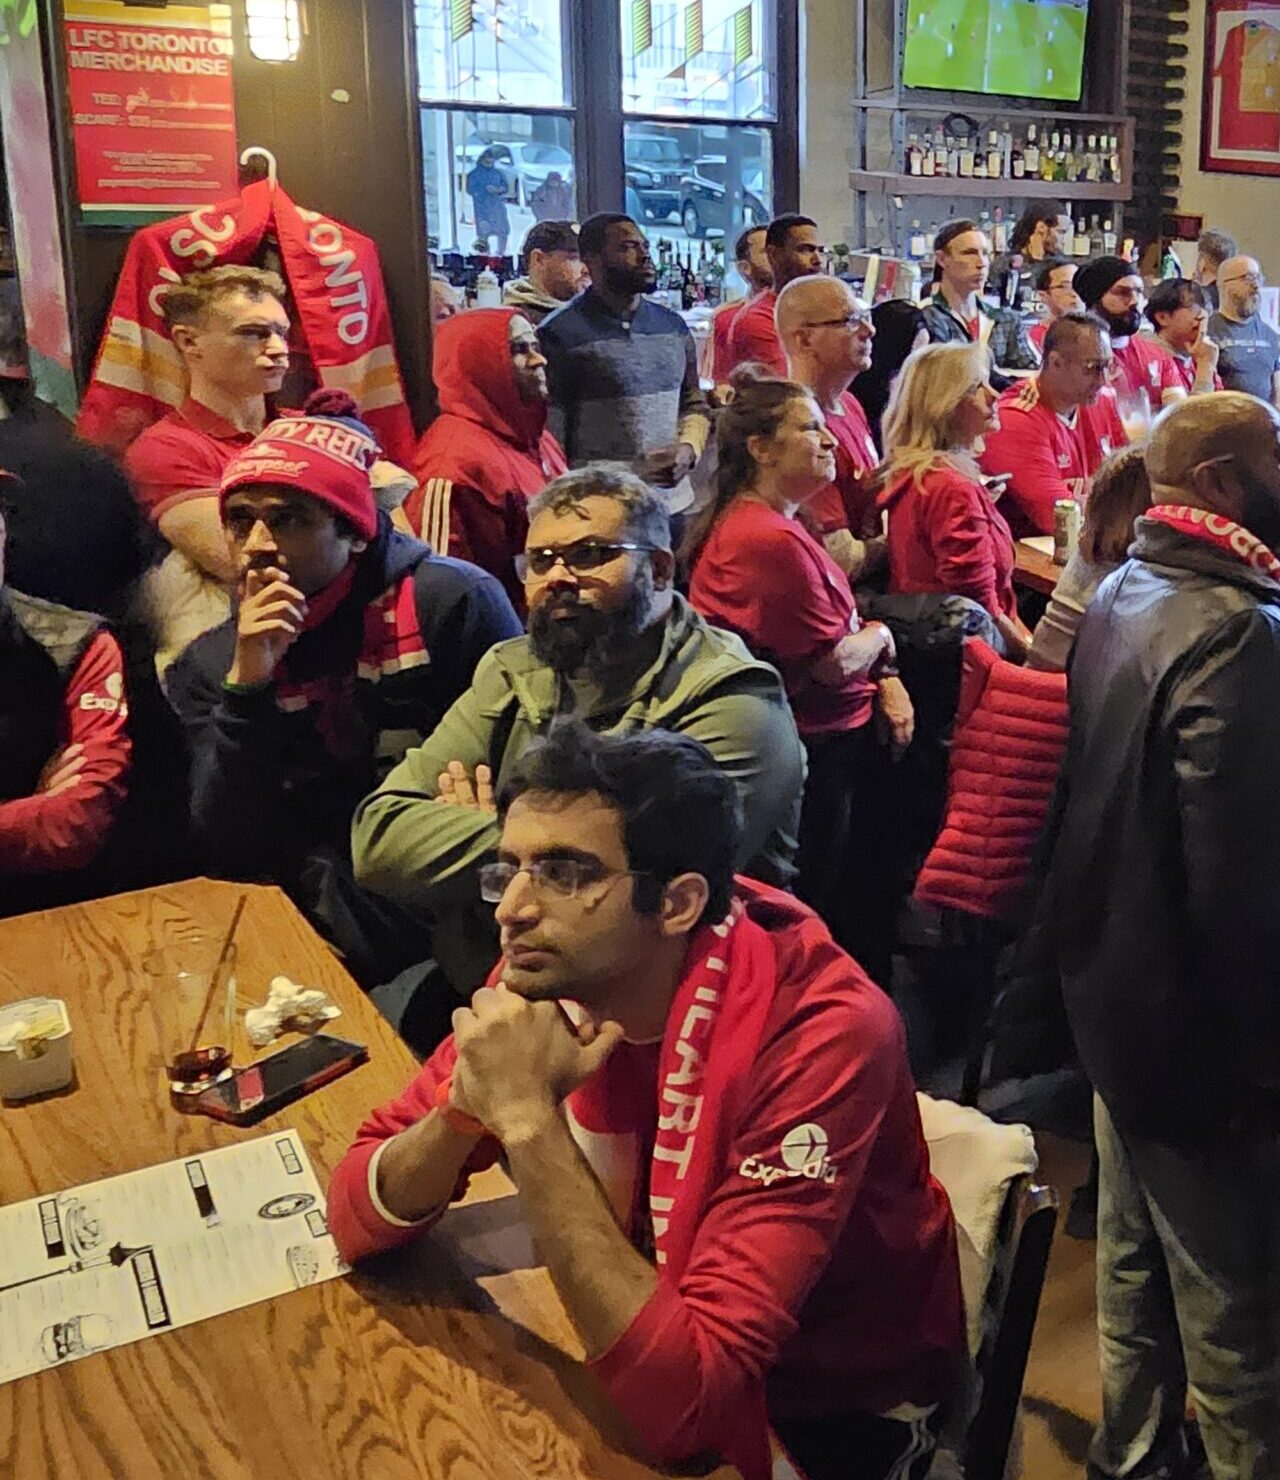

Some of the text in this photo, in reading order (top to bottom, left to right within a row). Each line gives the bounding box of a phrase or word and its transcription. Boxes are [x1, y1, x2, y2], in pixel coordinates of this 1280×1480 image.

[69, 28, 230, 56] LFC TORONTO
[69, 50, 230, 77] MERCHANDISE
